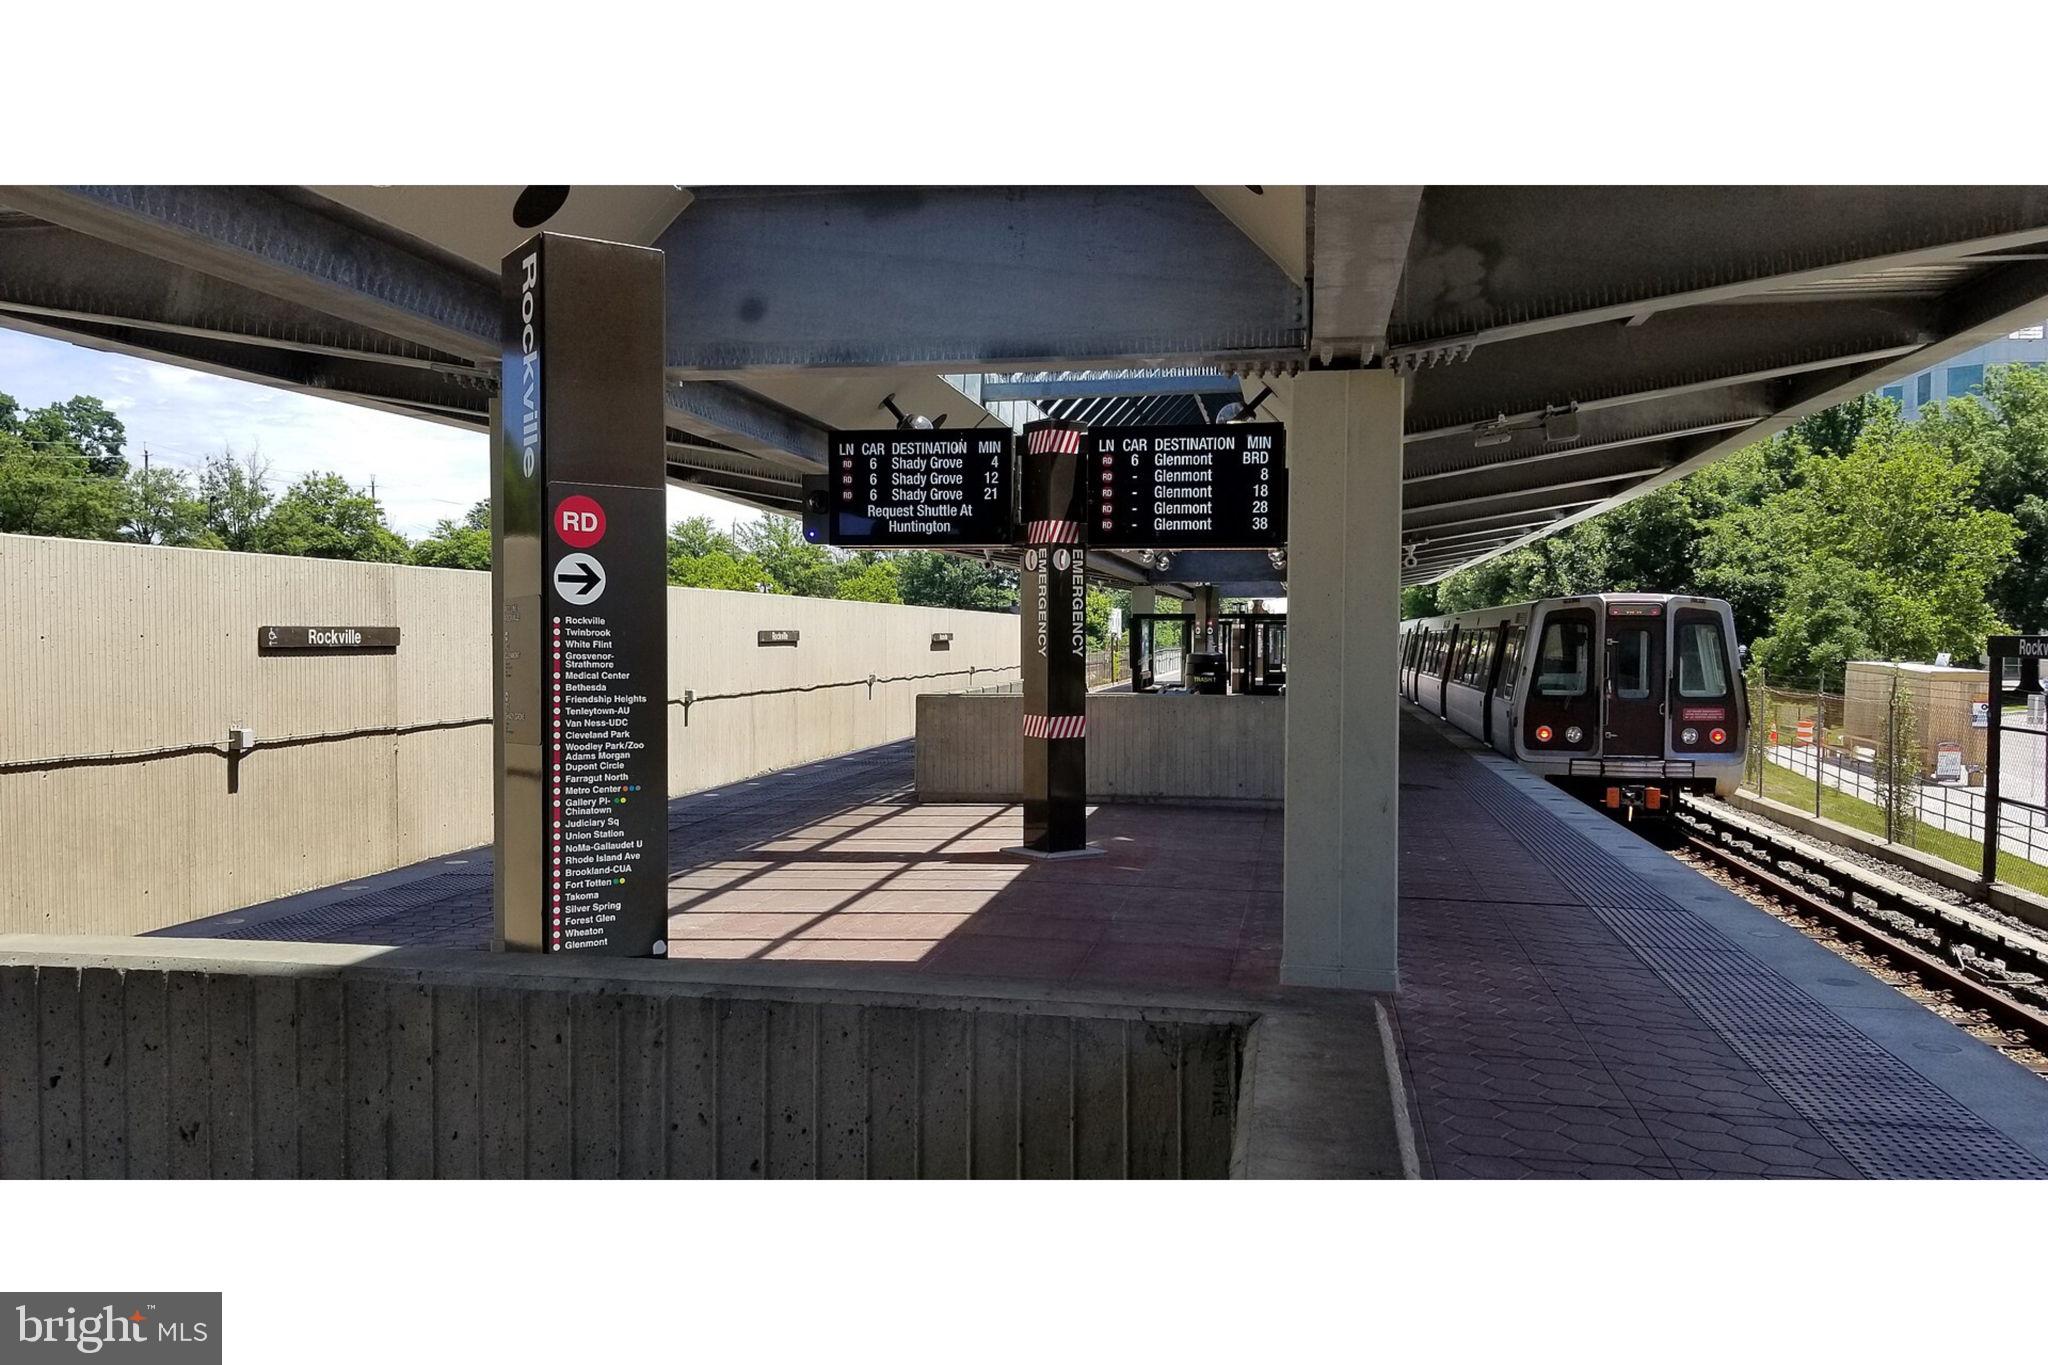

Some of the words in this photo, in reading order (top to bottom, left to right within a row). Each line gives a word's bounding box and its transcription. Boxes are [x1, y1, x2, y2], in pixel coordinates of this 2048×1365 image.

[522, 252, 538, 479] Rockville
[839, 443, 854, 455] LN
[862, 443, 885, 455] CAR
[892, 441, 967, 455] DESTINATION
[978, 441, 1001, 453] MIN
[1099, 439, 1114, 451] LN
[1122, 439, 1147, 451] CAR
[1155, 437, 1235, 450] DESTINATION
[1247, 436, 1271, 448] MIN
[842, 460, 852, 468] RD
[870, 458, 877, 469] 6
[891, 457, 927, 471] Shady
[930, 458, 962, 469] Grove
[991, 456, 998, 468] 4
[1102, 457, 1112, 465] RD
[1131, 454, 1139, 466] 6
[1154, 453, 1213, 466] Glenmont
[1242, 451, 1268, 464] BRD
[842, 476, 852, 484] RD
[870, 473, 877, 485] 6
[891, 472, 927, 487] Shady
[930, 473, 962, 484] Grove
[984, 472, 998, 484] 12
[1102, 473, 1112, 481] RD
[1154, 469, 1212, 482] Glenmont
[1260, 468, 1268, 481] 8
[842, 492, 852, 500] RD
[870, 489, 877, 501] 6
[891, 488, 927, 503] Shady
[930, 489, 962, 500] Grove
[984, 488, 998, 500] 21
[1102, 489, 1112, 497] RD
[1154, 485, 1212, 498] Glenmont
[1253, 484, 1268, 497] 18
[868, 505, 914, 519] Request
[917, 505, 957, 517] Shuttle
[960, 504, 972, 517] At
[1102, 505, 1112, 513] RD
[1154, 501, 1212, 514] Glenmont
[1252, 501, 1268, 514] 28
[563, 511, 598, 532] RD
[889, 520, 951, 534] Huntington
[1102, 521, 1112, 529] RD
[1154, 517, 1212, 530] Glenmont
[1252, 517, 1268, 530] 38
[1038, 548, 1046, 657] EMERGENCY
[1072, 549, 1083, 657] EMERGENCY
[565, 616, 606, 625] Rockville
[308, 629, 361, 644] Rockville
[565, 628, 611, 637] Twinbrook
[565, 640, 590, 649] White
[593, 640, 612, 649] Flint
[565, 652, 614, 660] Grosvenor-
[565, 660, 614, 669] Strathmore
[565, 672, 599, 680] Medical
[601, 671, 630, 680] Center
[565, 683, 607, 692] Bethesda
[565, 695, 612, 705] Friendship
[614, 695, 647, 705] Heights
[565, 707, 630, 717] Tenleytown-AU
[565, 720, 581, 728] Van
[584, 718, 628, 727] Ness-UDC
[565, 731, 608, 740] Cleveland
[565, 743, 603, 751] Woodley
[605, 742, 645, 750] Park/Zoo
[565, 753, 596, 761] Adams
[598, 752, 630, 761] Morgan
[565, 763, 597, 772] Dupont
[600, 762, 625, 770] Circle
[565, 775, 602, 784] Farragut
[605, 773, 628, 781] North
[565, 787, 590, 795] Metro
[593, 785, 621, 794] Center
[565, 798, 596, 807] Gallery
[565, 807, 612, 816] Chinatown
[565, 819, 605, 828] Judiciary
[608, 818, 619, 826] Sq
[565, 831, 591, 840] Union
[594, 830, 624, 839] Station
[565, 841, 634, 852] NoMa-Gallaudet
[637, 840, 643, 848] U
[565, 856, 594, 864] Rhode
[596, 853, 623, 862] Island
[625, 852, 640, 860] Ave
[565, 865, 632, 877] Brookland-CUA
[565, 880, 584, 889] Fort
[586, 878, 612, 888] Totten
[565, 892, 599, 901] Takoma
[565, 905, 590, 914] Silver
[593, 902, 621, 912] Spring
[565, 916, 593, 925] Forest
[596, 914, 616, 923] Glen
[565, 928, 604, 938] Wheaton
[565, 938, 608, 949] Glenmont
